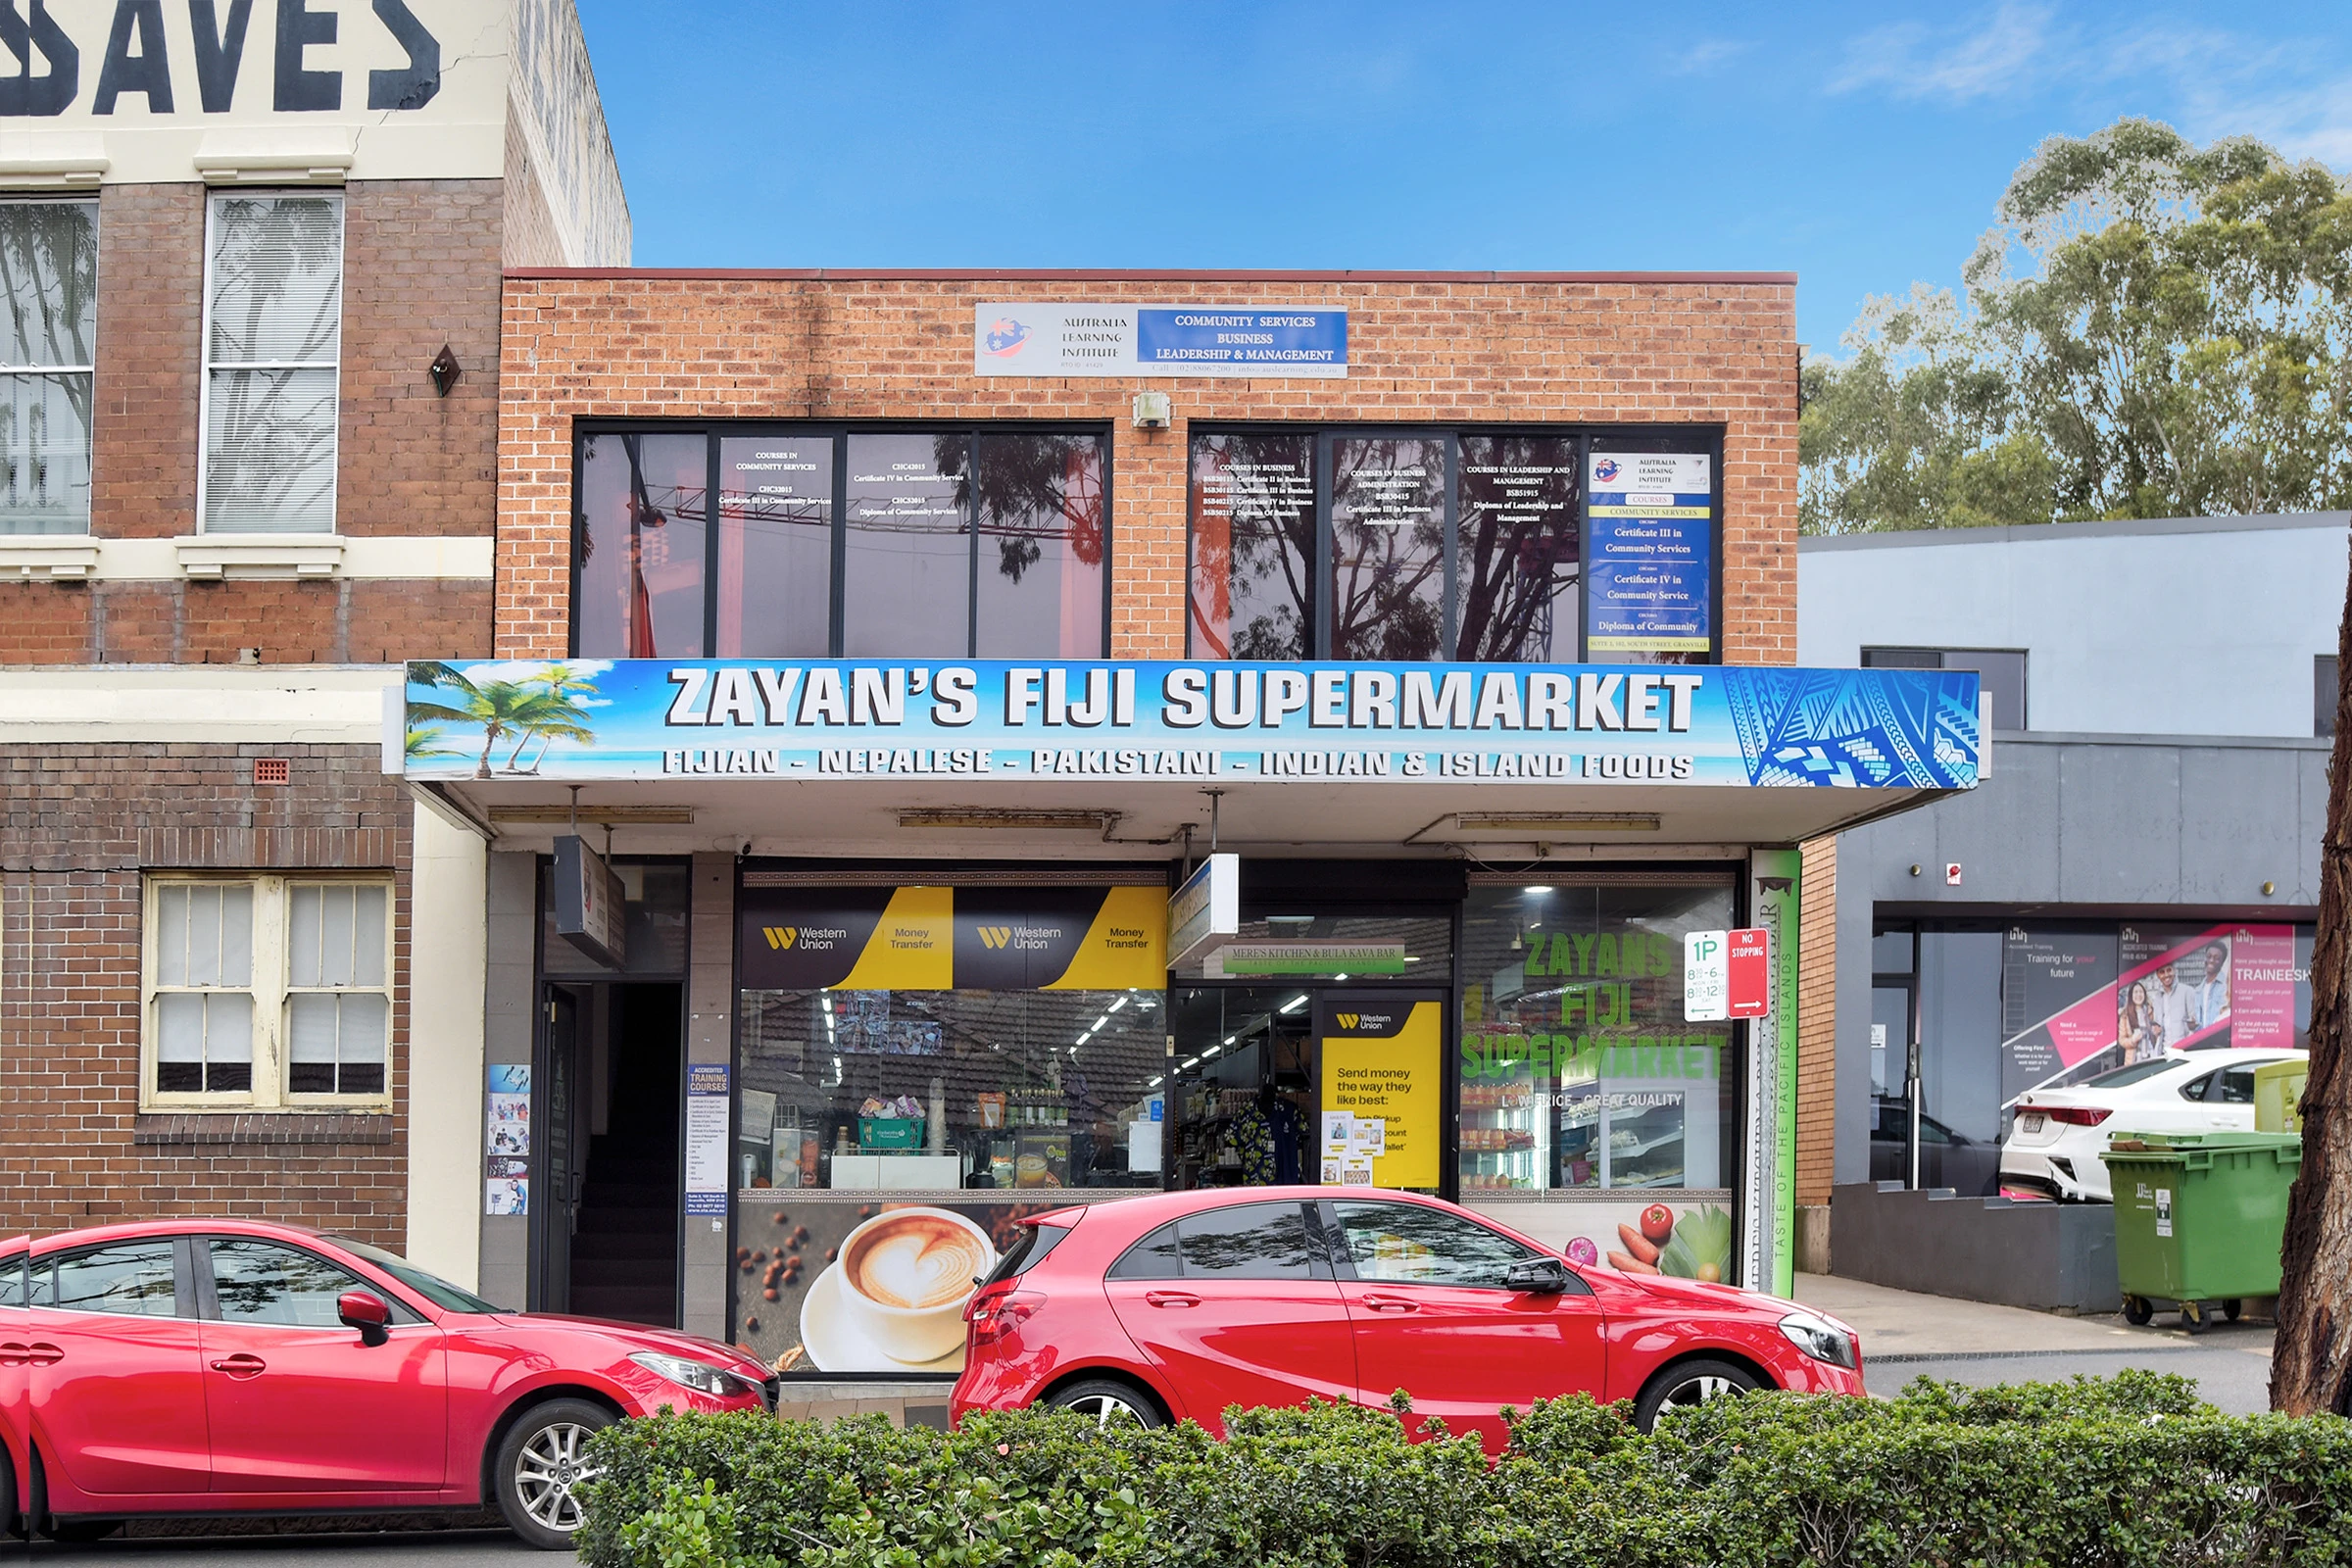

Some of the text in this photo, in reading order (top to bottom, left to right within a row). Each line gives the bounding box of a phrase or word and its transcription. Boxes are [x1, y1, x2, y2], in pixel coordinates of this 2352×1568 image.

[1063, 318, 1128, 327] AUSTRALIA
[1175, 316, 1316, 327] COMMUNITY SERVICES
[1062, 333, 1122, 343] LEARNING
[1217, 333, 1273, 344] BUSINESS
[1062, 348, 1119, 358] INSTITUTE
[1156, 348, 1334, 361] LEADERSHIP & MANAGEMENT
[769, 497, 807, 506] Community
[1473, 502, 1502, 511] Diploma
[1512, 502, 1549, 511] Leadership
[1496, 514, 1540, 523] Management
[1614, 528, 1682, 538] Certificate III in
[1605, 543, 1691, 556] Community Services
[1614, 574, 1682, 584] Certificate IV in
[1607, 590, 1690, 601] Community Service
[1598, 621, 1698, 633] Diploma of Community
[663, 667, 1703, 732] ZAYAN'S FIJI SUPERMARKET
[662, 748, 1695, 780] FIJIAN NEPALESE PAKISTANI INDIAN & ISLAND FOODS
[800, 926, 847, 940] Western
[895, 927, 929, 941] Money
[1013, 926, 1061, 940] Western
[1109, 927, 1145, 941] Money
[1741, 934, 1753, 944] NO
[800, 938, 834, 951] Union
[890, 938, 934, 950] Transfer
[1013, 938, 1049, 950] Union
[1104, 938, 1149, 950] Transfer
[1232, 949, 1396, 958] MERE'S KITCHEN & BULA KAVA BAR
[1524, 933, 1672, 976] ZAYANS
[1693, 941, 1717, 961] 1P
[1732, 947, 1764, 957] STOPPING
[2027, 954, 2060, 965] Training
[2062, 954, 2074, 963] for
[2050, 968, 2075, 978] future
[1561, 984, 1631, 1026] FIJI
[1360, 1013, 1391, 1024] Western
[1460, 1035, 1727, 1078] SUPERMARKET
[1338, 1068, 1410, 1080] Send money
[1338, 1082, 1411, 1094] the way they
[1337, 1096, 1389, 1104] like best:
[1501, 1095, 1529, 1107] LOW
[1584, 1095, 1623, 1106] GREAT
[1628, 1094, 1682, 1106] QUALITY
[1775, 952, 1792, 1259] TASTE OF THE PACIFIC ISLANDS
